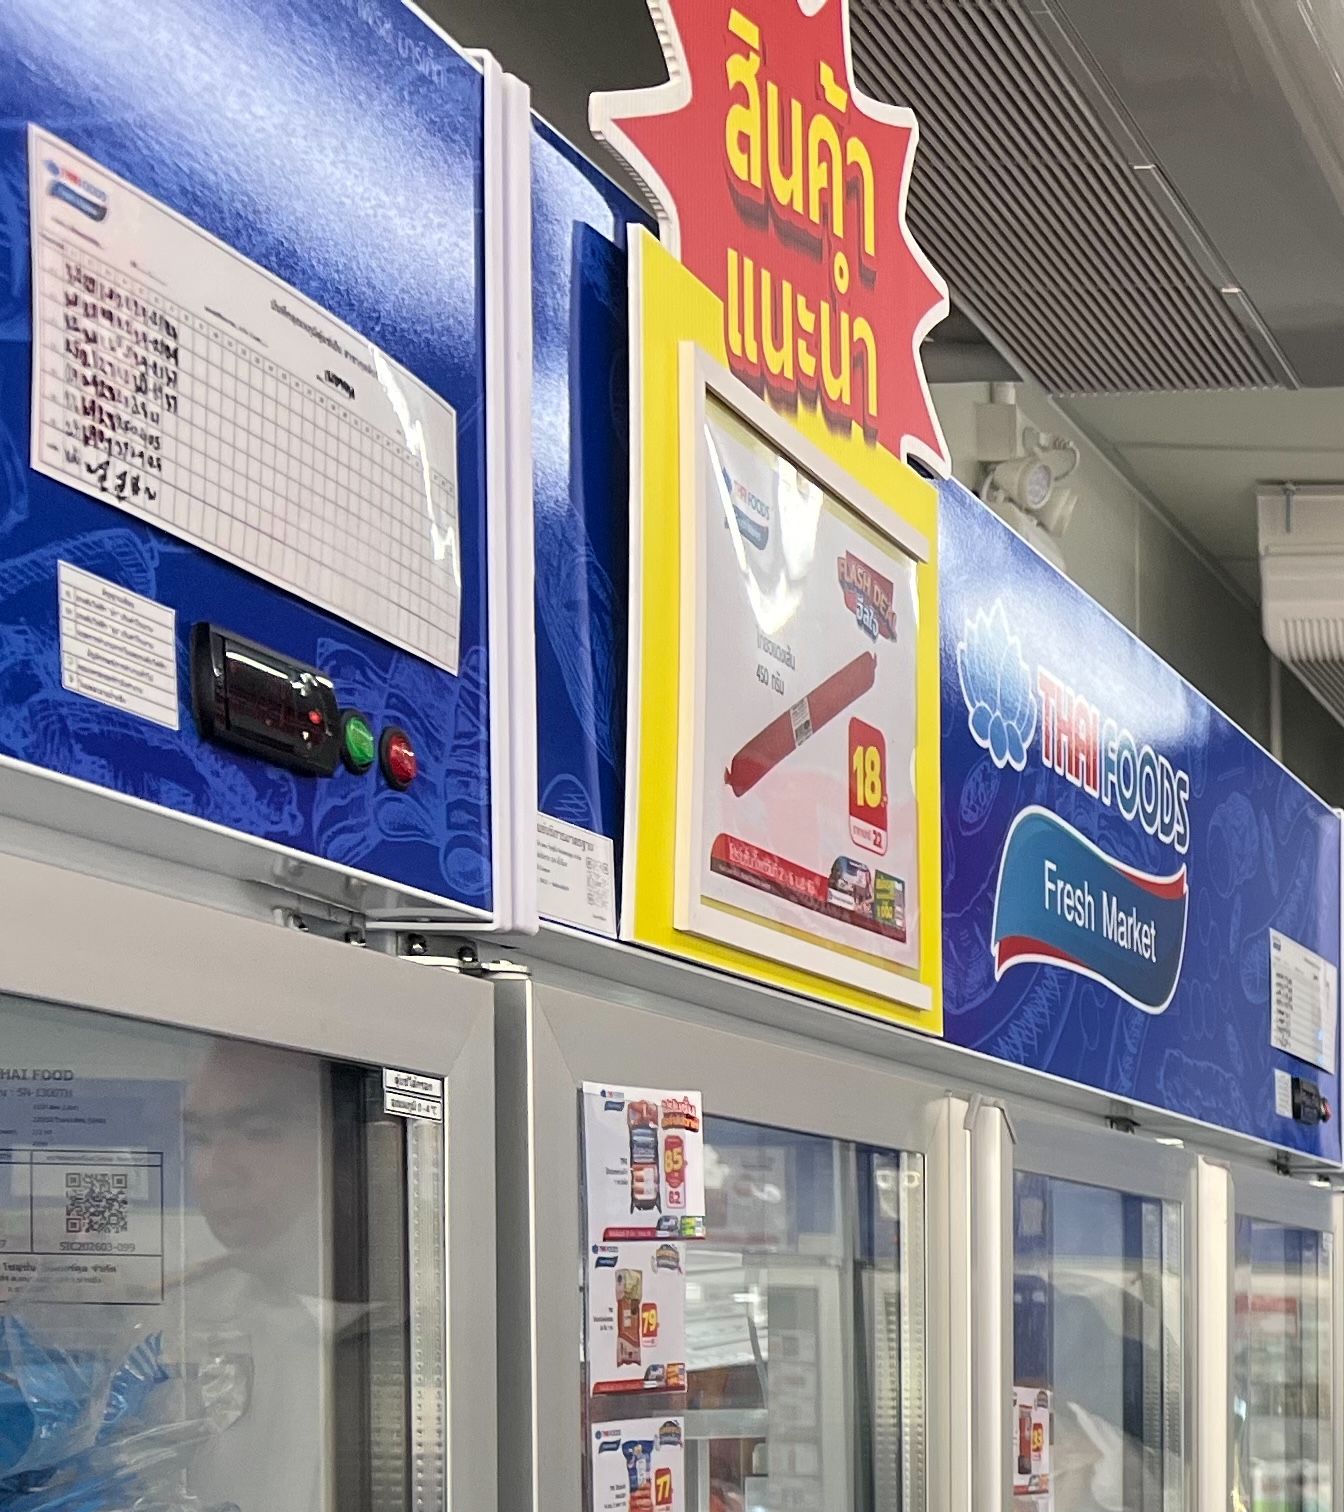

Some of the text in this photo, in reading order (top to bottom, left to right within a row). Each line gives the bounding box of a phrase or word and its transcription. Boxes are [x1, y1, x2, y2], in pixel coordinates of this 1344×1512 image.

[725, 8, 875, 257] สินค้า
[727, 247, 878, 417] แนะนำ
[1038, 666, 1190, 854] THAI FOODS
[1044, 859, 1157, 963] Fresh Market
[0, 1069, 74, 1081] HAI FOOD
[664, 1149, 684, 1174] 85
[643, 1309, 658, 1335] 79
